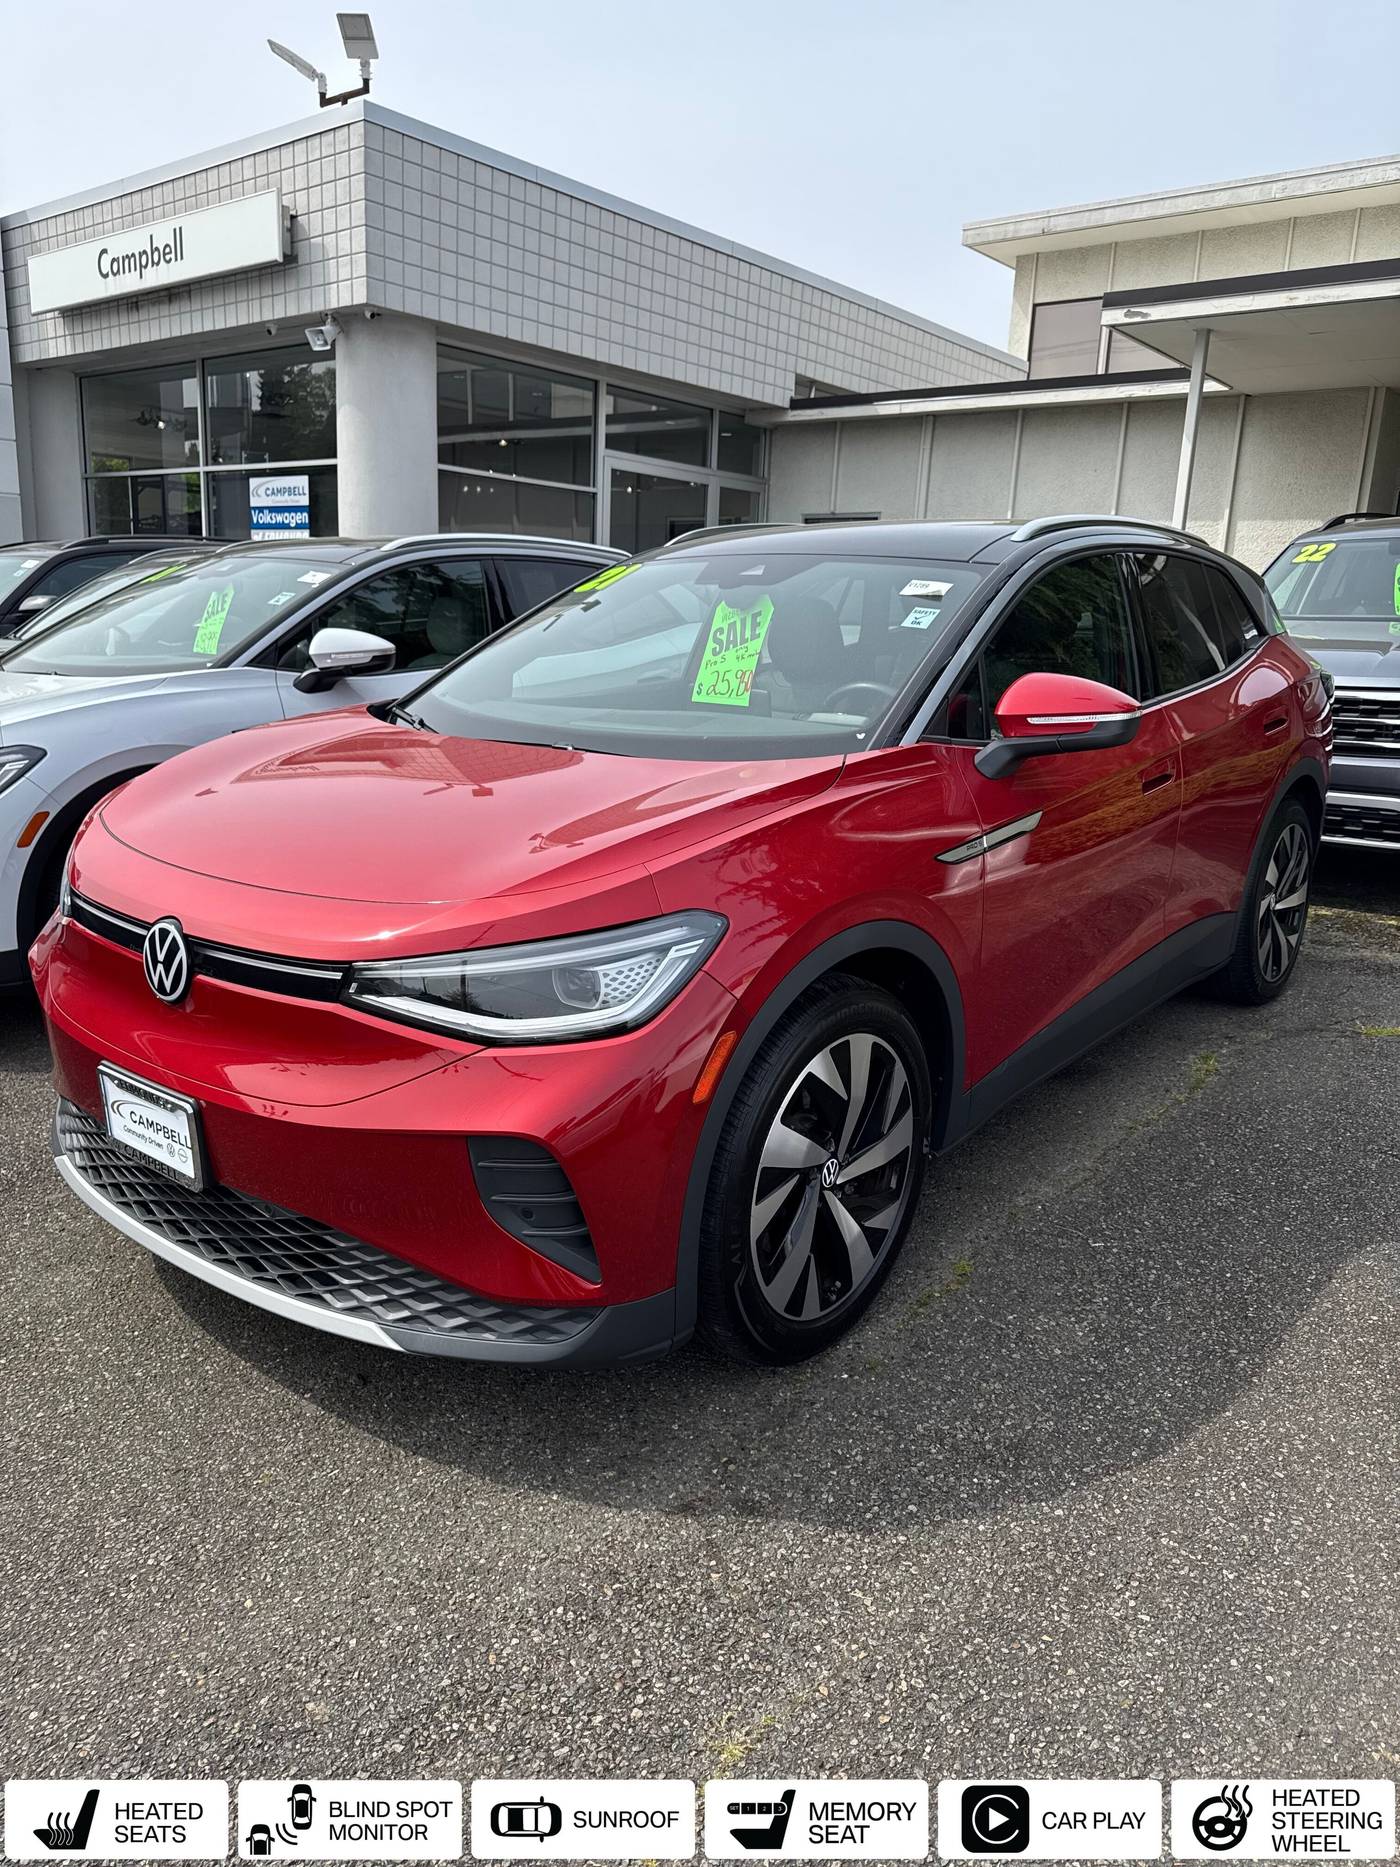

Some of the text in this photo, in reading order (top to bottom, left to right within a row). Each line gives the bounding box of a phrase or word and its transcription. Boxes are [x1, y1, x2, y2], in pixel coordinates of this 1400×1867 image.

[97, 226, 185, 279] Campbell
[264, 486, 307, 497] CAMPBELL
[251, 509, 309, 527] Volkswagen
[1292, 543, 1336, 563] 22
[711, 610, 762, 657] SALE
[129, 1110, 191, 1149] CAMPBELL
[124, 1144, 178, 1182] CAMPBELL
